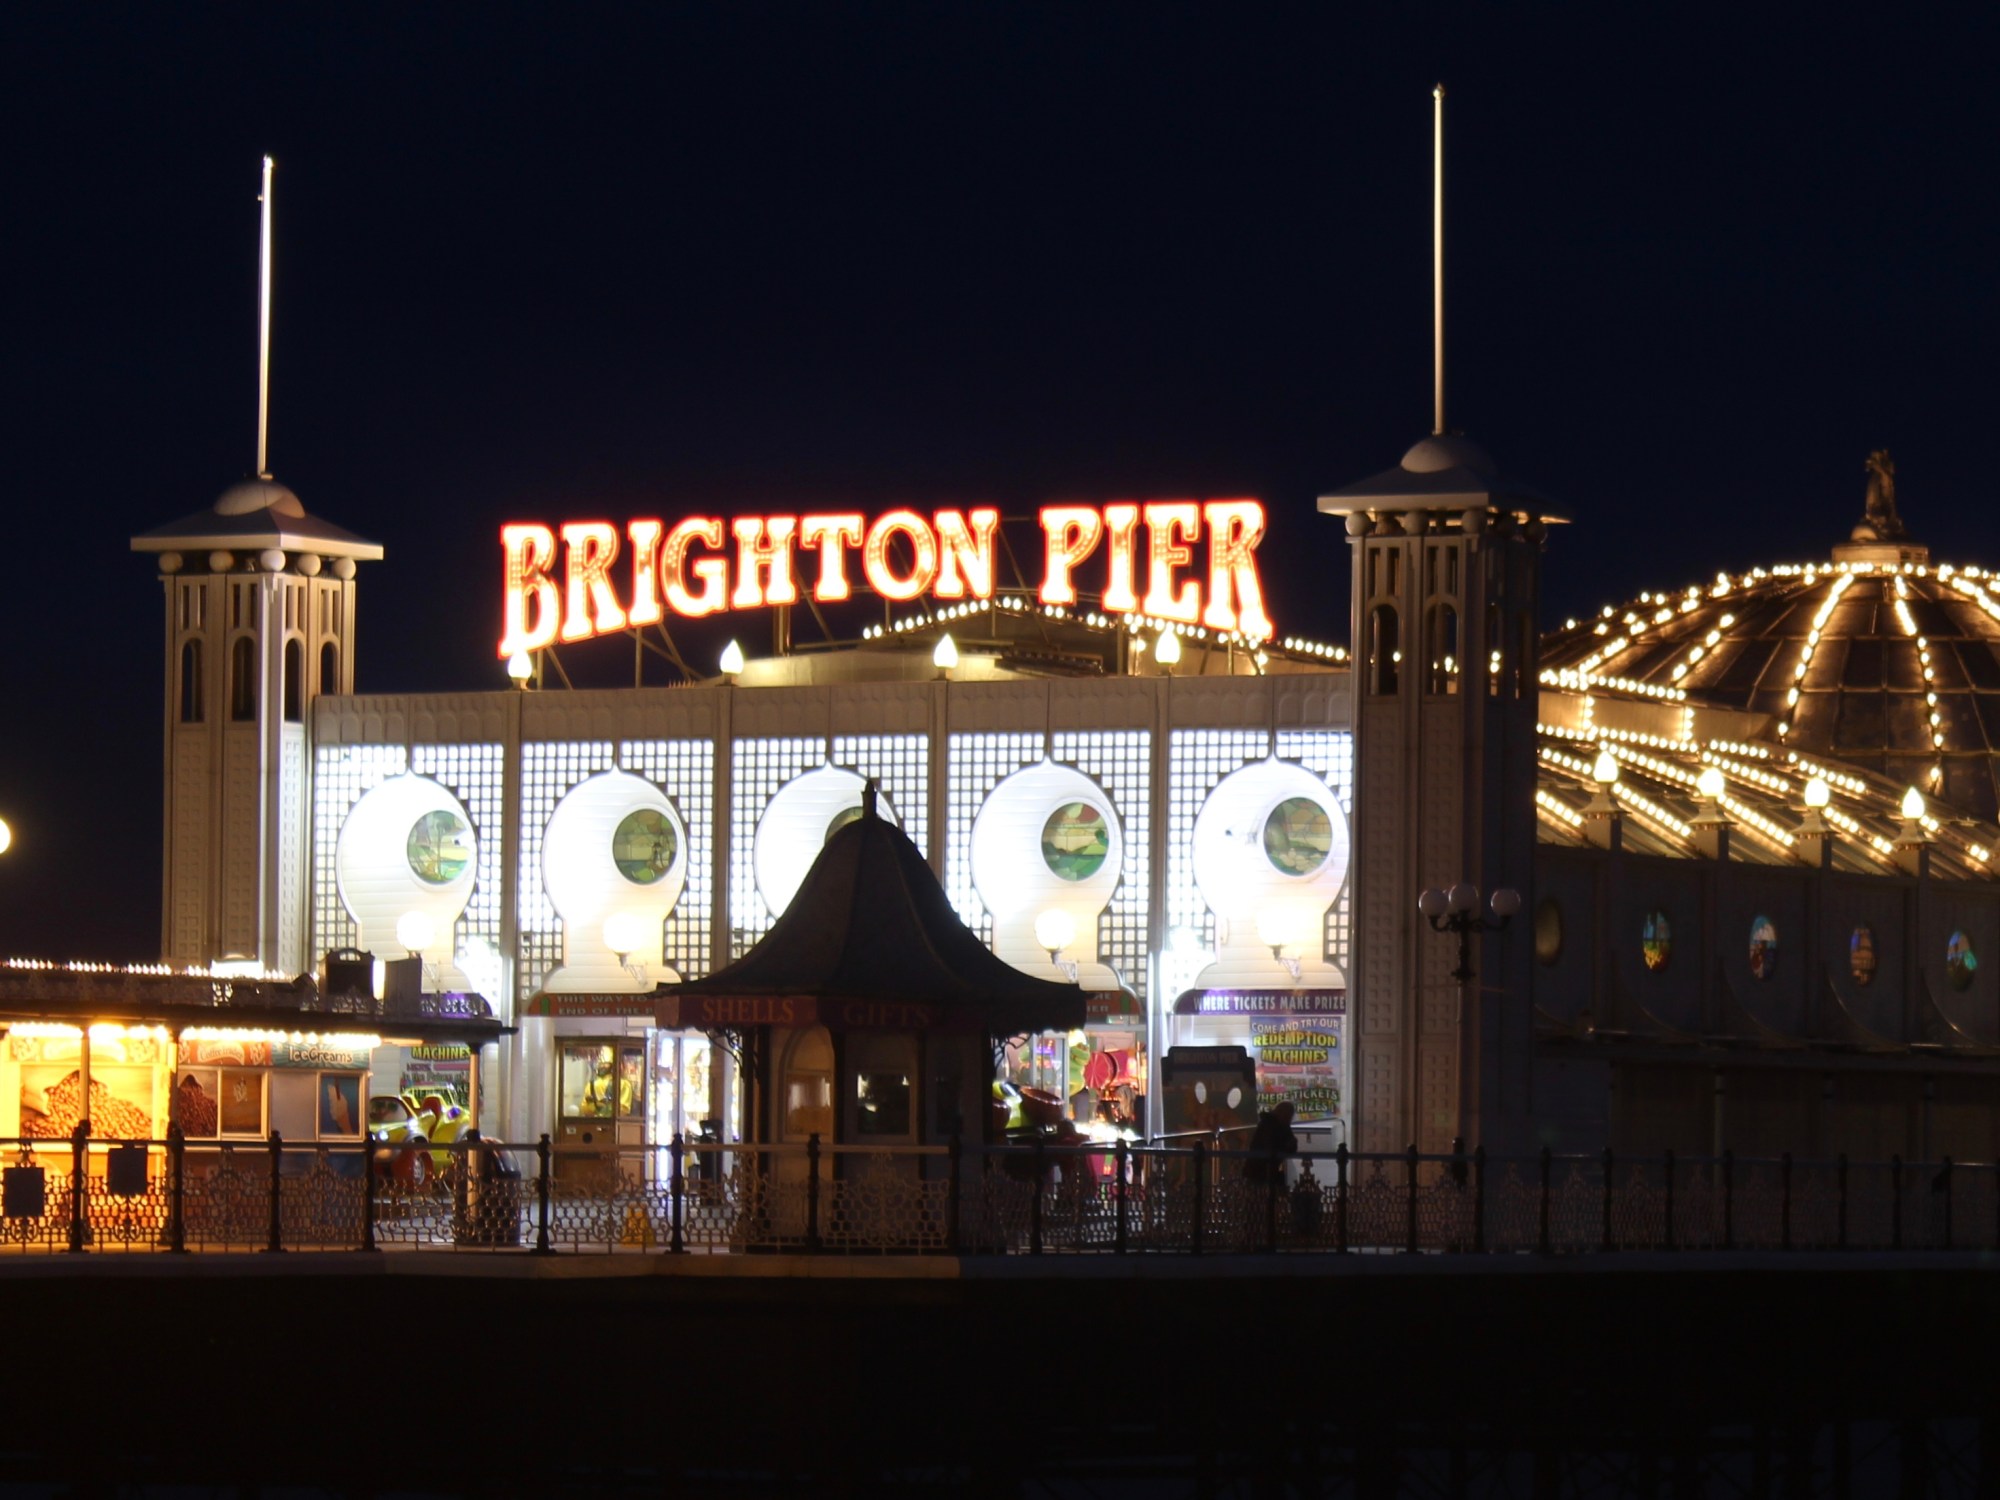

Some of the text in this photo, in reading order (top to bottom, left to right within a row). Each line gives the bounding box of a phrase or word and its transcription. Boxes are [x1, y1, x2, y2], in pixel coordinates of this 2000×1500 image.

[498, 499, 1275, 658] BRIGHTON PIER
[557, 994, 648, 1004] THIS WAY TO
[1193, 995, 1230, 1011] WHERE
[1234, 996, 1275, 1011] TICKETS
[1280, 996, 1310, 1010] MAKE
[558, 1006, 586, 1016] END
[592, 1006, 610, 1016] OF
[616, 1006, 638, 1016] THE
[702, 998, 795, 1023] SHELLS
[843, 1002, 930, 1027] GIFTS
[1251, 1017, 1339, 1034] COME AND TRY OUR
[1252, 1031, 1337, 1047] REDEMPTION
[288, 1045, 353, 1064] Ice Creams
[412, 1045, 472, 1060] MACHINES
[1262, 1048, 1328, 1064] MACHINES
[1293, 1087, 1338, 1101] TICKETS
[1294, 1101, 1328, 1113] RIZES
